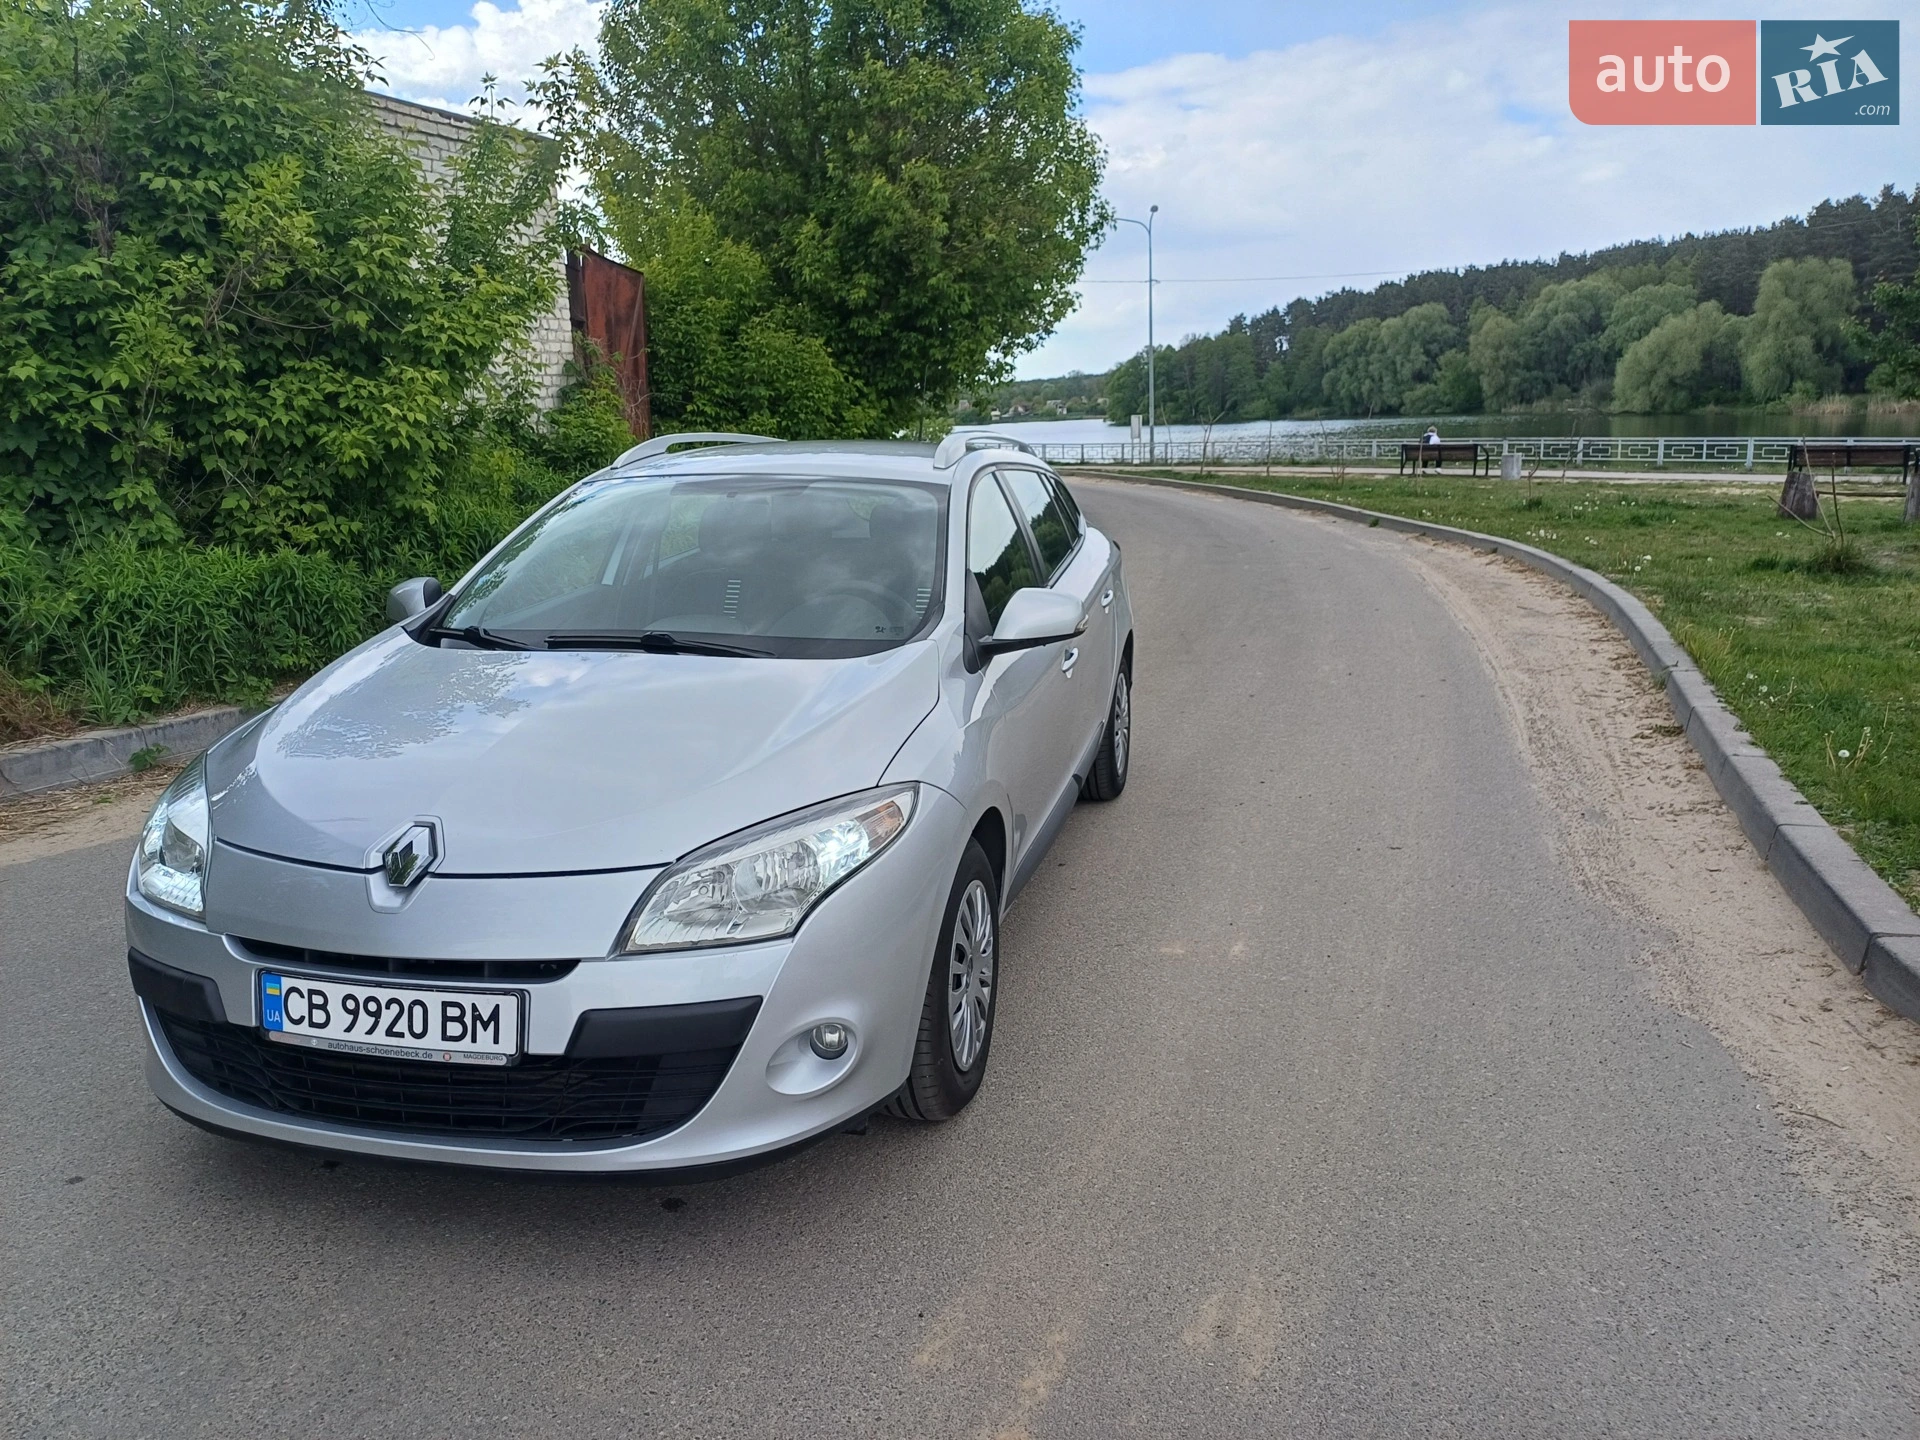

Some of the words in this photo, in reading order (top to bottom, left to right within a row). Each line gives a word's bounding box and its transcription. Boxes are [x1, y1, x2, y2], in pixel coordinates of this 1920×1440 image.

[267, 1009, 281, 1023] UA
[283, 986, 331, 1029] CB
[341, 993, 429, 1040] 9920
[441, 1001, 500, 1045] BM
[327, 1041, 433, 1060] autohaus-schoenebeck.de
[463, 1053, 504, 1061] MAGDEBURG
